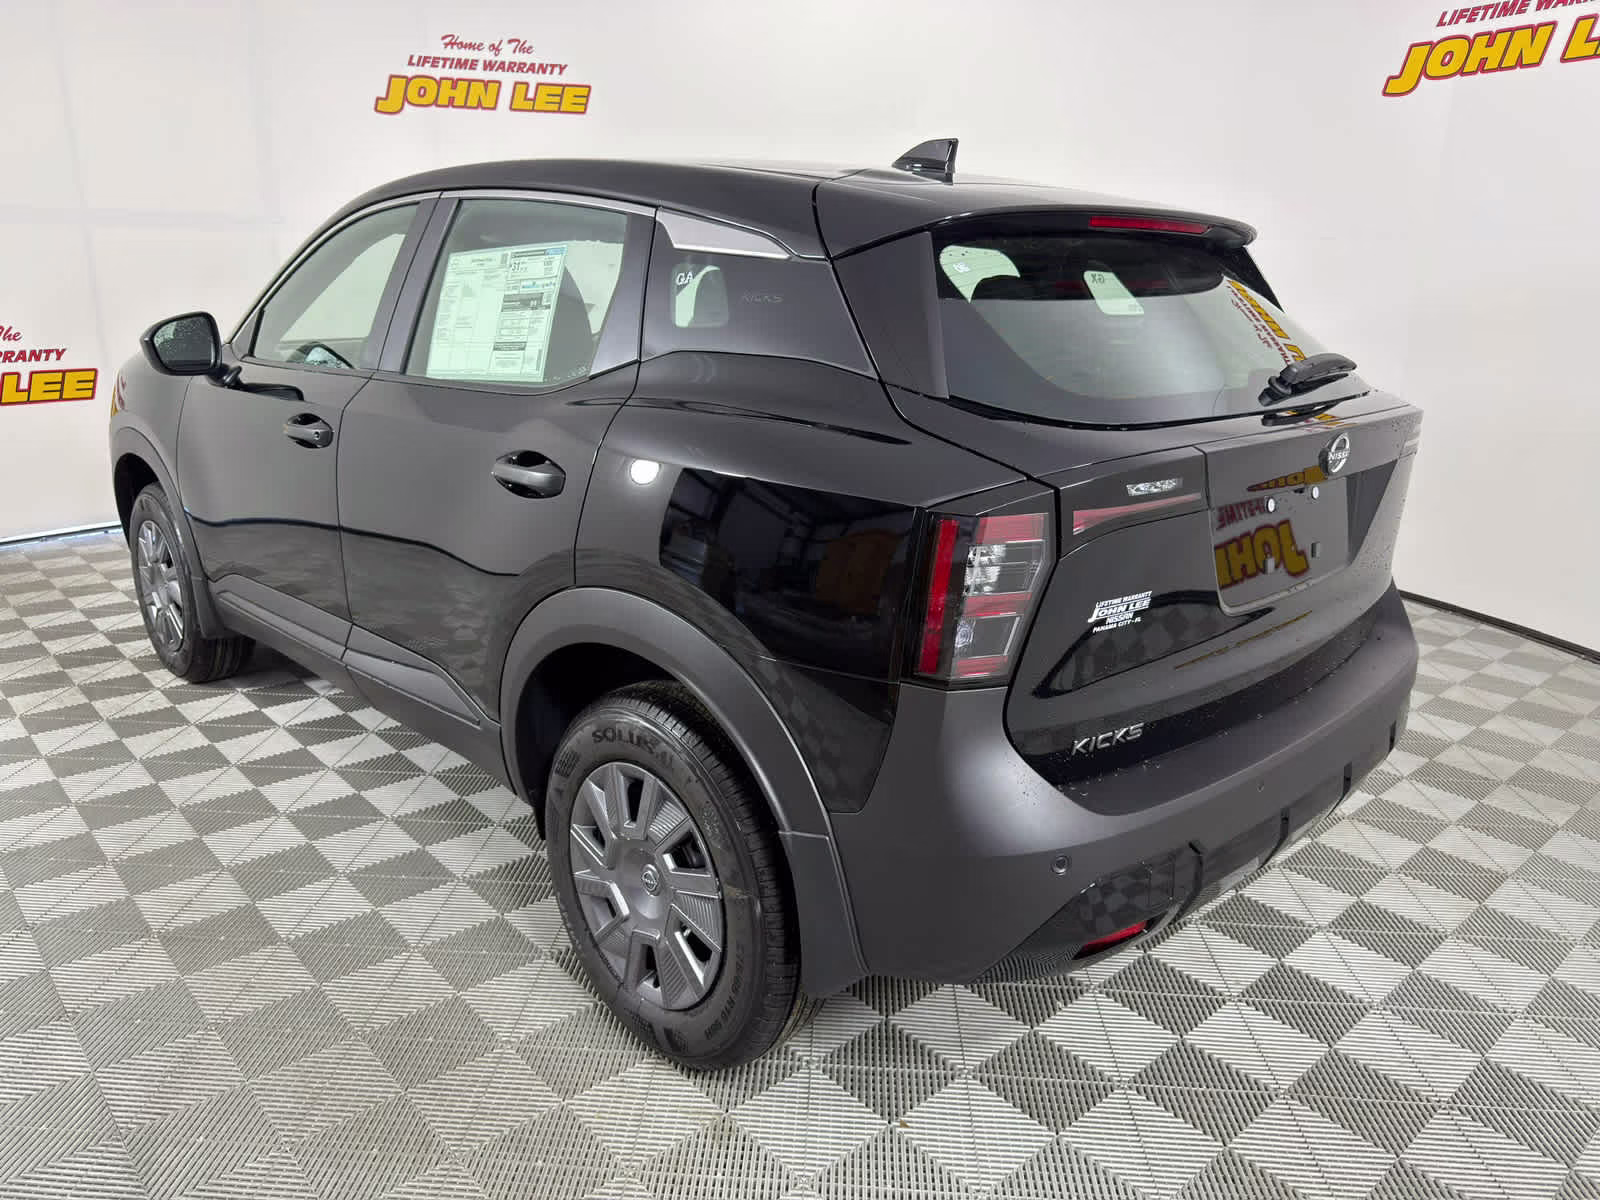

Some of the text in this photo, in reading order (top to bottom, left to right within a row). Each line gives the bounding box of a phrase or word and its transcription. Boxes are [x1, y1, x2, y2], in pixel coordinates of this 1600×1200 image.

[1436, 0, 1530, 27] LIFETIME
[441, 34, 534, 55] Home of The
[1382, 13, 1600, 97] JOHN L
[407, 55, 568, 76] LIFETIME WARRANTY
[374, 74, 592, 115] JOHN LEE
[0, 348, 66, 363] RANTY
[0, 368, 98, 406] LEE
[1088, 599, 1150, 623] JOHN LEE
[1106, 611, 1134, 624] NISSAN
[1071, 722, 1145, 756] KICKS
